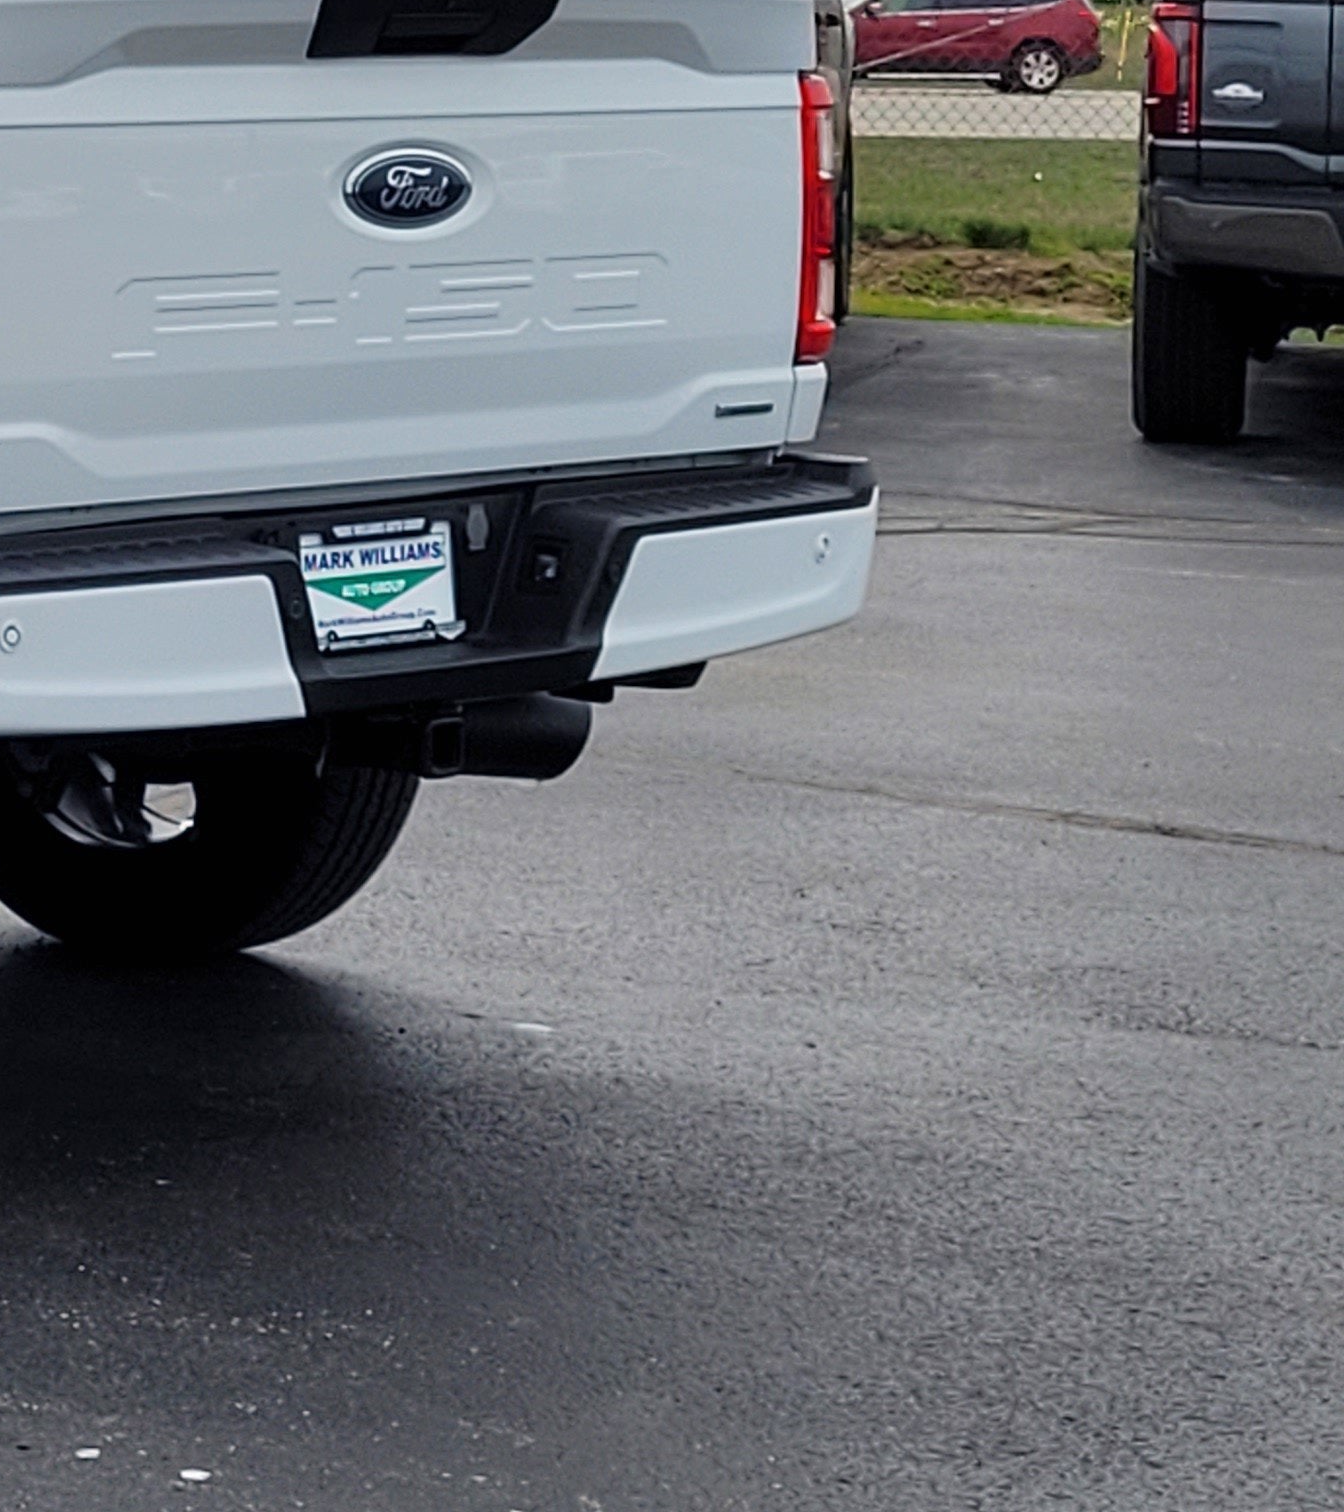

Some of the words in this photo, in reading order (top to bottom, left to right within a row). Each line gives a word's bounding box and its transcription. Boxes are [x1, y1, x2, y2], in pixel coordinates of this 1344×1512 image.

[380, 165, 449, 208] Ford
[304, 550, 354, 571] MARK
[359, 541, 442, 566] WILLIAMS
